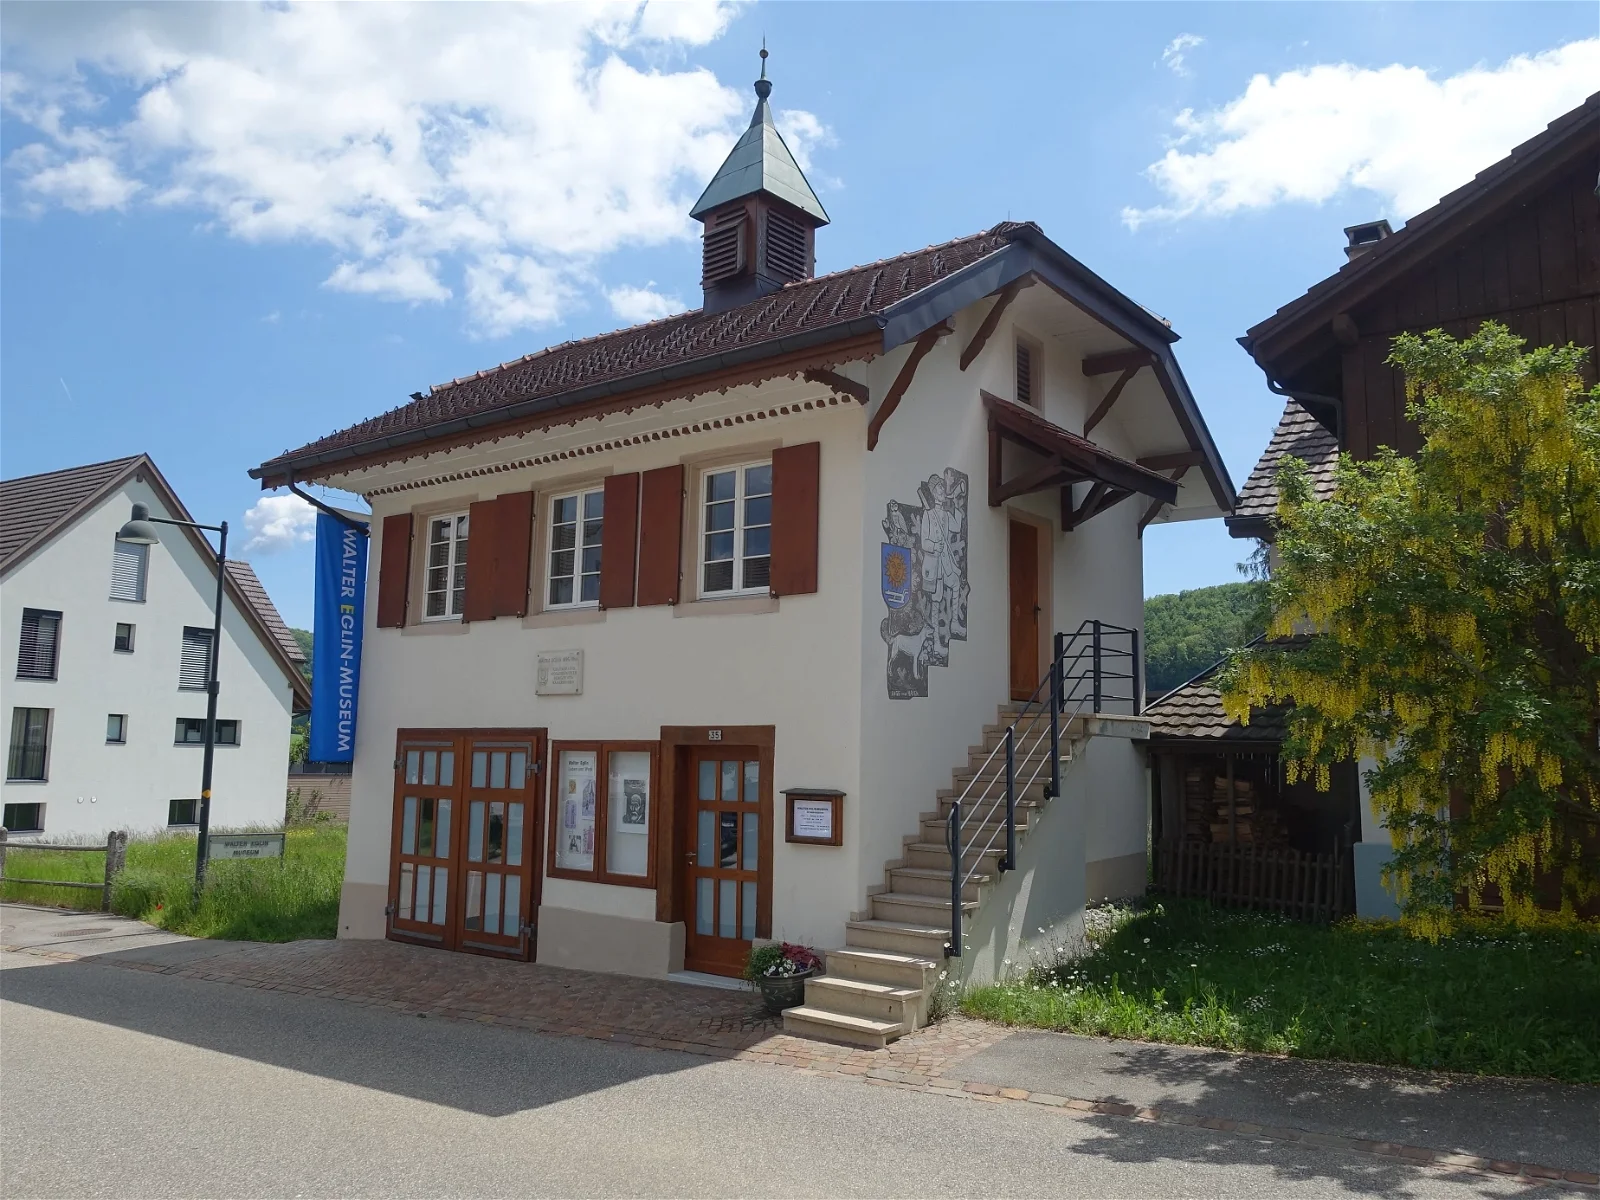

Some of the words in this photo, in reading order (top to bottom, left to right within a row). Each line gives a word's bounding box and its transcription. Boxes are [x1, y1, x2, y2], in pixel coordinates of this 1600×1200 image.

[341, 529, 357, 598] WALTER
[337, 604, 355, 752] EGLIN-MUSEUM
[710, 731, 720, 739] 35
